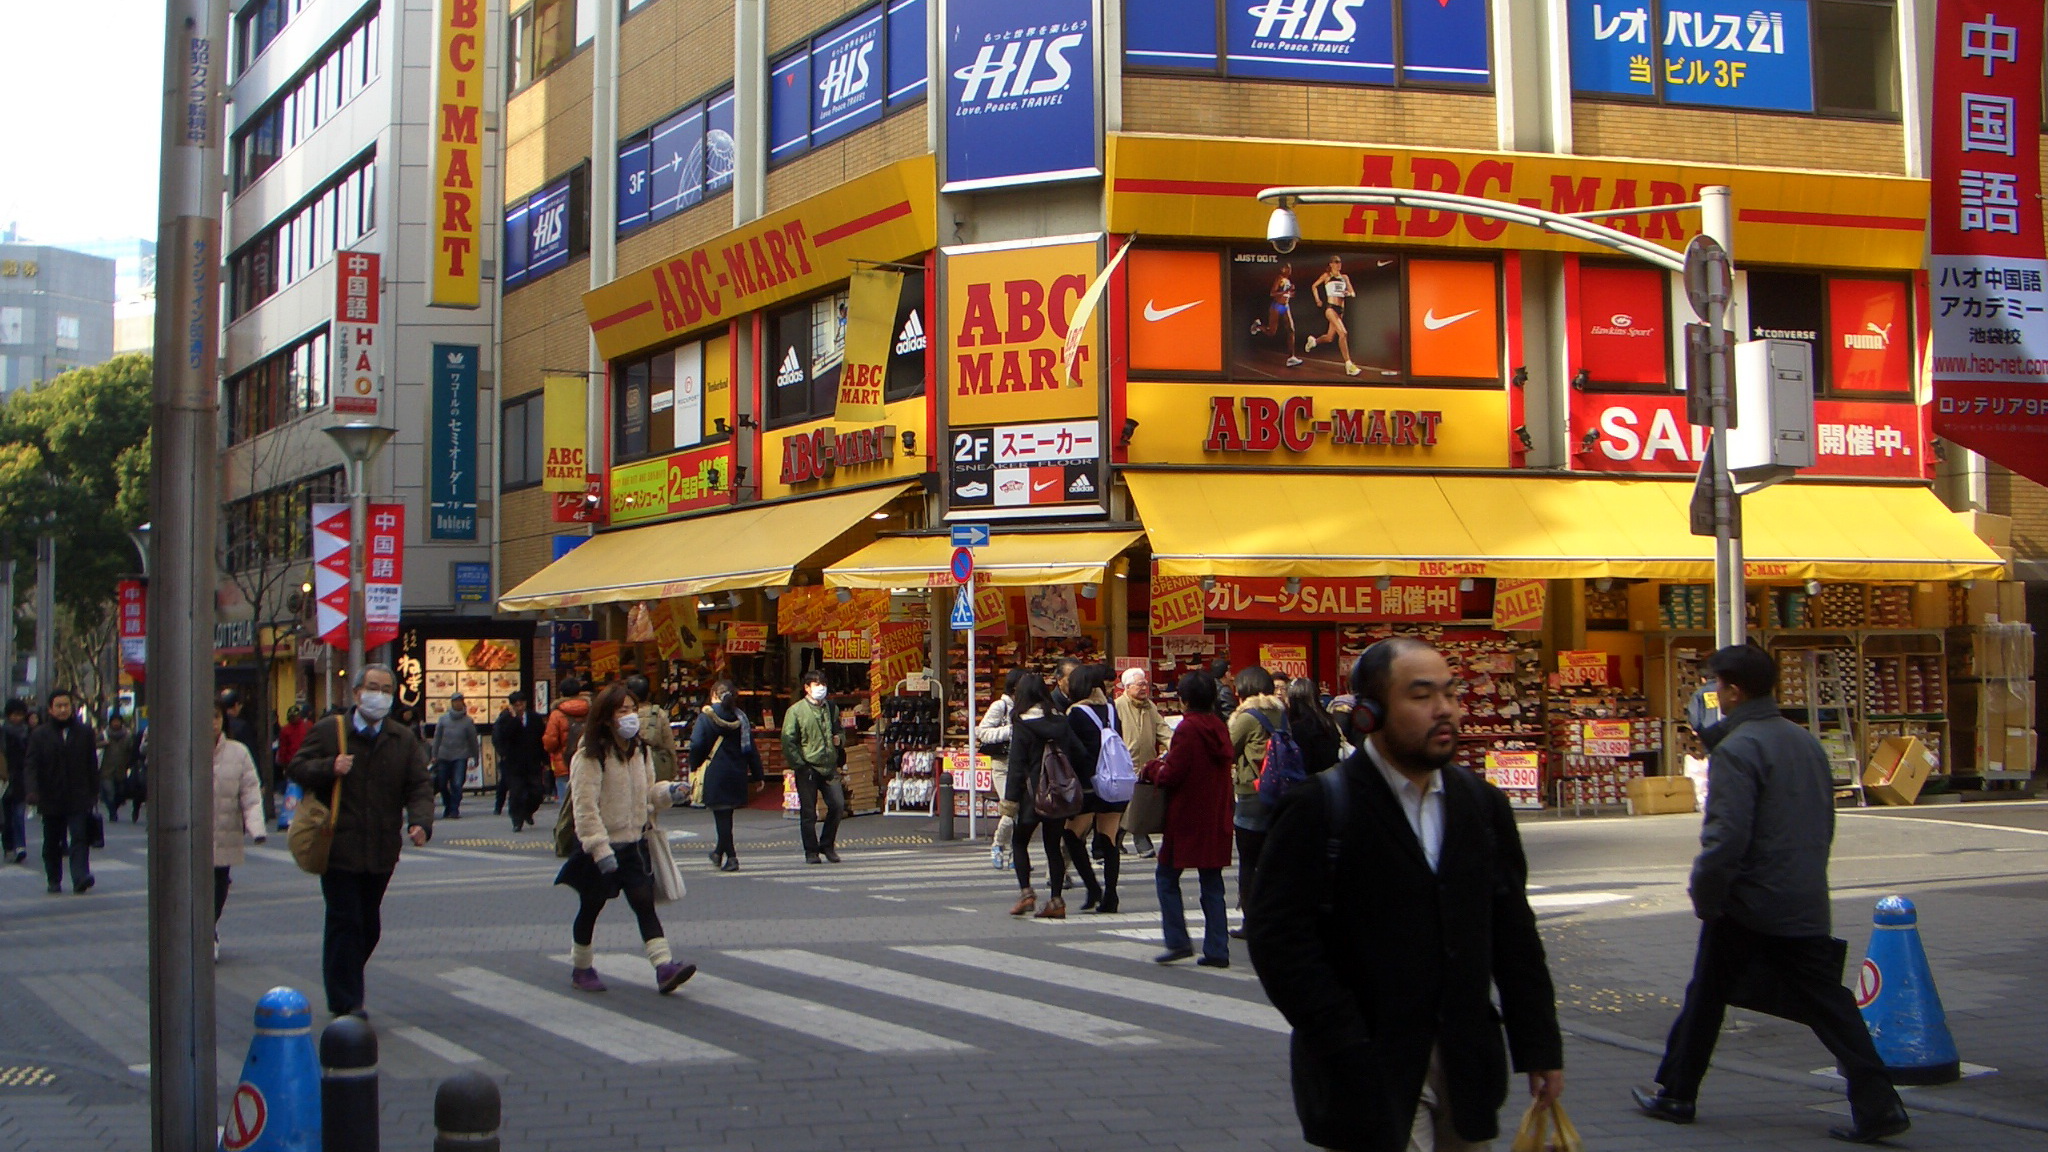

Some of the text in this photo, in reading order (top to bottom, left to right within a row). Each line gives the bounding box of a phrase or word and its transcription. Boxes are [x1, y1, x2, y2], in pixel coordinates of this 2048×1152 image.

[984, 20, 1087, 42] もっと世界を楽しもう
[1593, 4, 1785, 55] レオパレス21
[1251, 39, 1276, 50] Love,
[1311, 43, 1350, 54] TRAVEL
[819, 40, 875, 108] H.I.S.
[954, 33, 1083, 102] H.I.S.
[955, 106, 982, 117] Love,
[1021, 94, 1063, 109] TRAVEL
[1959, 13, 2019, 234] 中国語
[629, 172, 645, 195] 3F
[1235, 254, 1256, 263] JUST
[1257, 254, 1268, 263] DO
[347, 254, 368, 319] 中国語
[652, 219, 813, 333] ABC-MART
[1940, 267, 2042, 292] ハオ中国語
[957, 274, 1087, 348] ABC
[1940, 296, 2044, 319] アカデミー
[895, 335, 927, 355] adidas
[1765, 329, 1816, 339] CONVERSE
[1844, 334, 1883, 349] PUMA
[1969, 327, 2021, 345] 池袋校
[777, 369, 804, 387] adidas
[843, 364, 883, 388] ABC
[957, 345, 1088, 396] MART
[840, 389, 880, 405] MART
[1203, 396, 1442, 452] ABC-MART
[955, 433, 989, 461] 2F
[1001, 428, 1092, 457] スニーカー
[547, 448, 583, 465] ABC
[780, 425, 890, 485] ABC-MART
[547, 466, 583, 479] MART
[373, 512, 396, 578] 中国語
[1419, 562, 1486, 576] ABC-MART
[1208, 581, 1372, 614] ガレージSALE
[1495, 586, 1543, 624] SALE!
[1151, 591, 1203, 630] SALE!
[960, 771, 990, 788] 1,95
